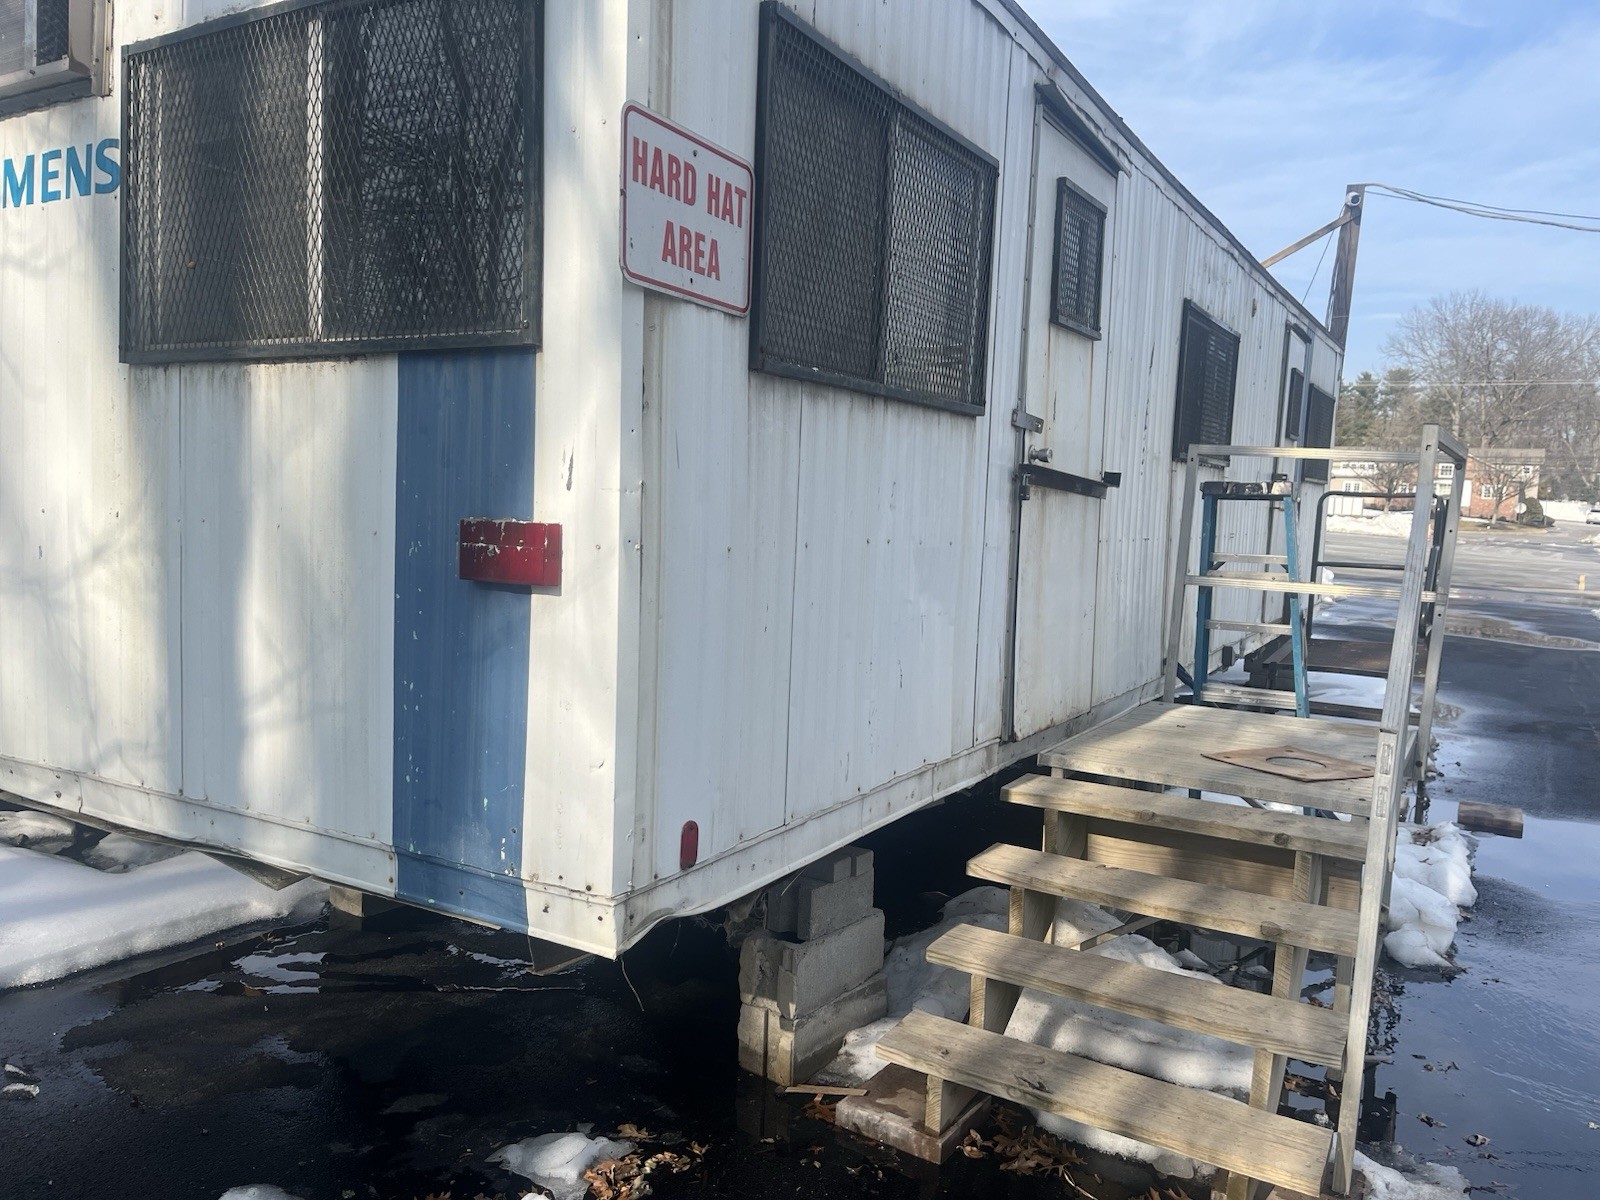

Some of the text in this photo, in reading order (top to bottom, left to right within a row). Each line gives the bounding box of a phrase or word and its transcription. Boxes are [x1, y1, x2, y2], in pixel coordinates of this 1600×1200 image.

[3, 138, 120, 208] MENS
[632, 136, 747, 228] HARD HAT
[661, 220, 720, 281] AREA
